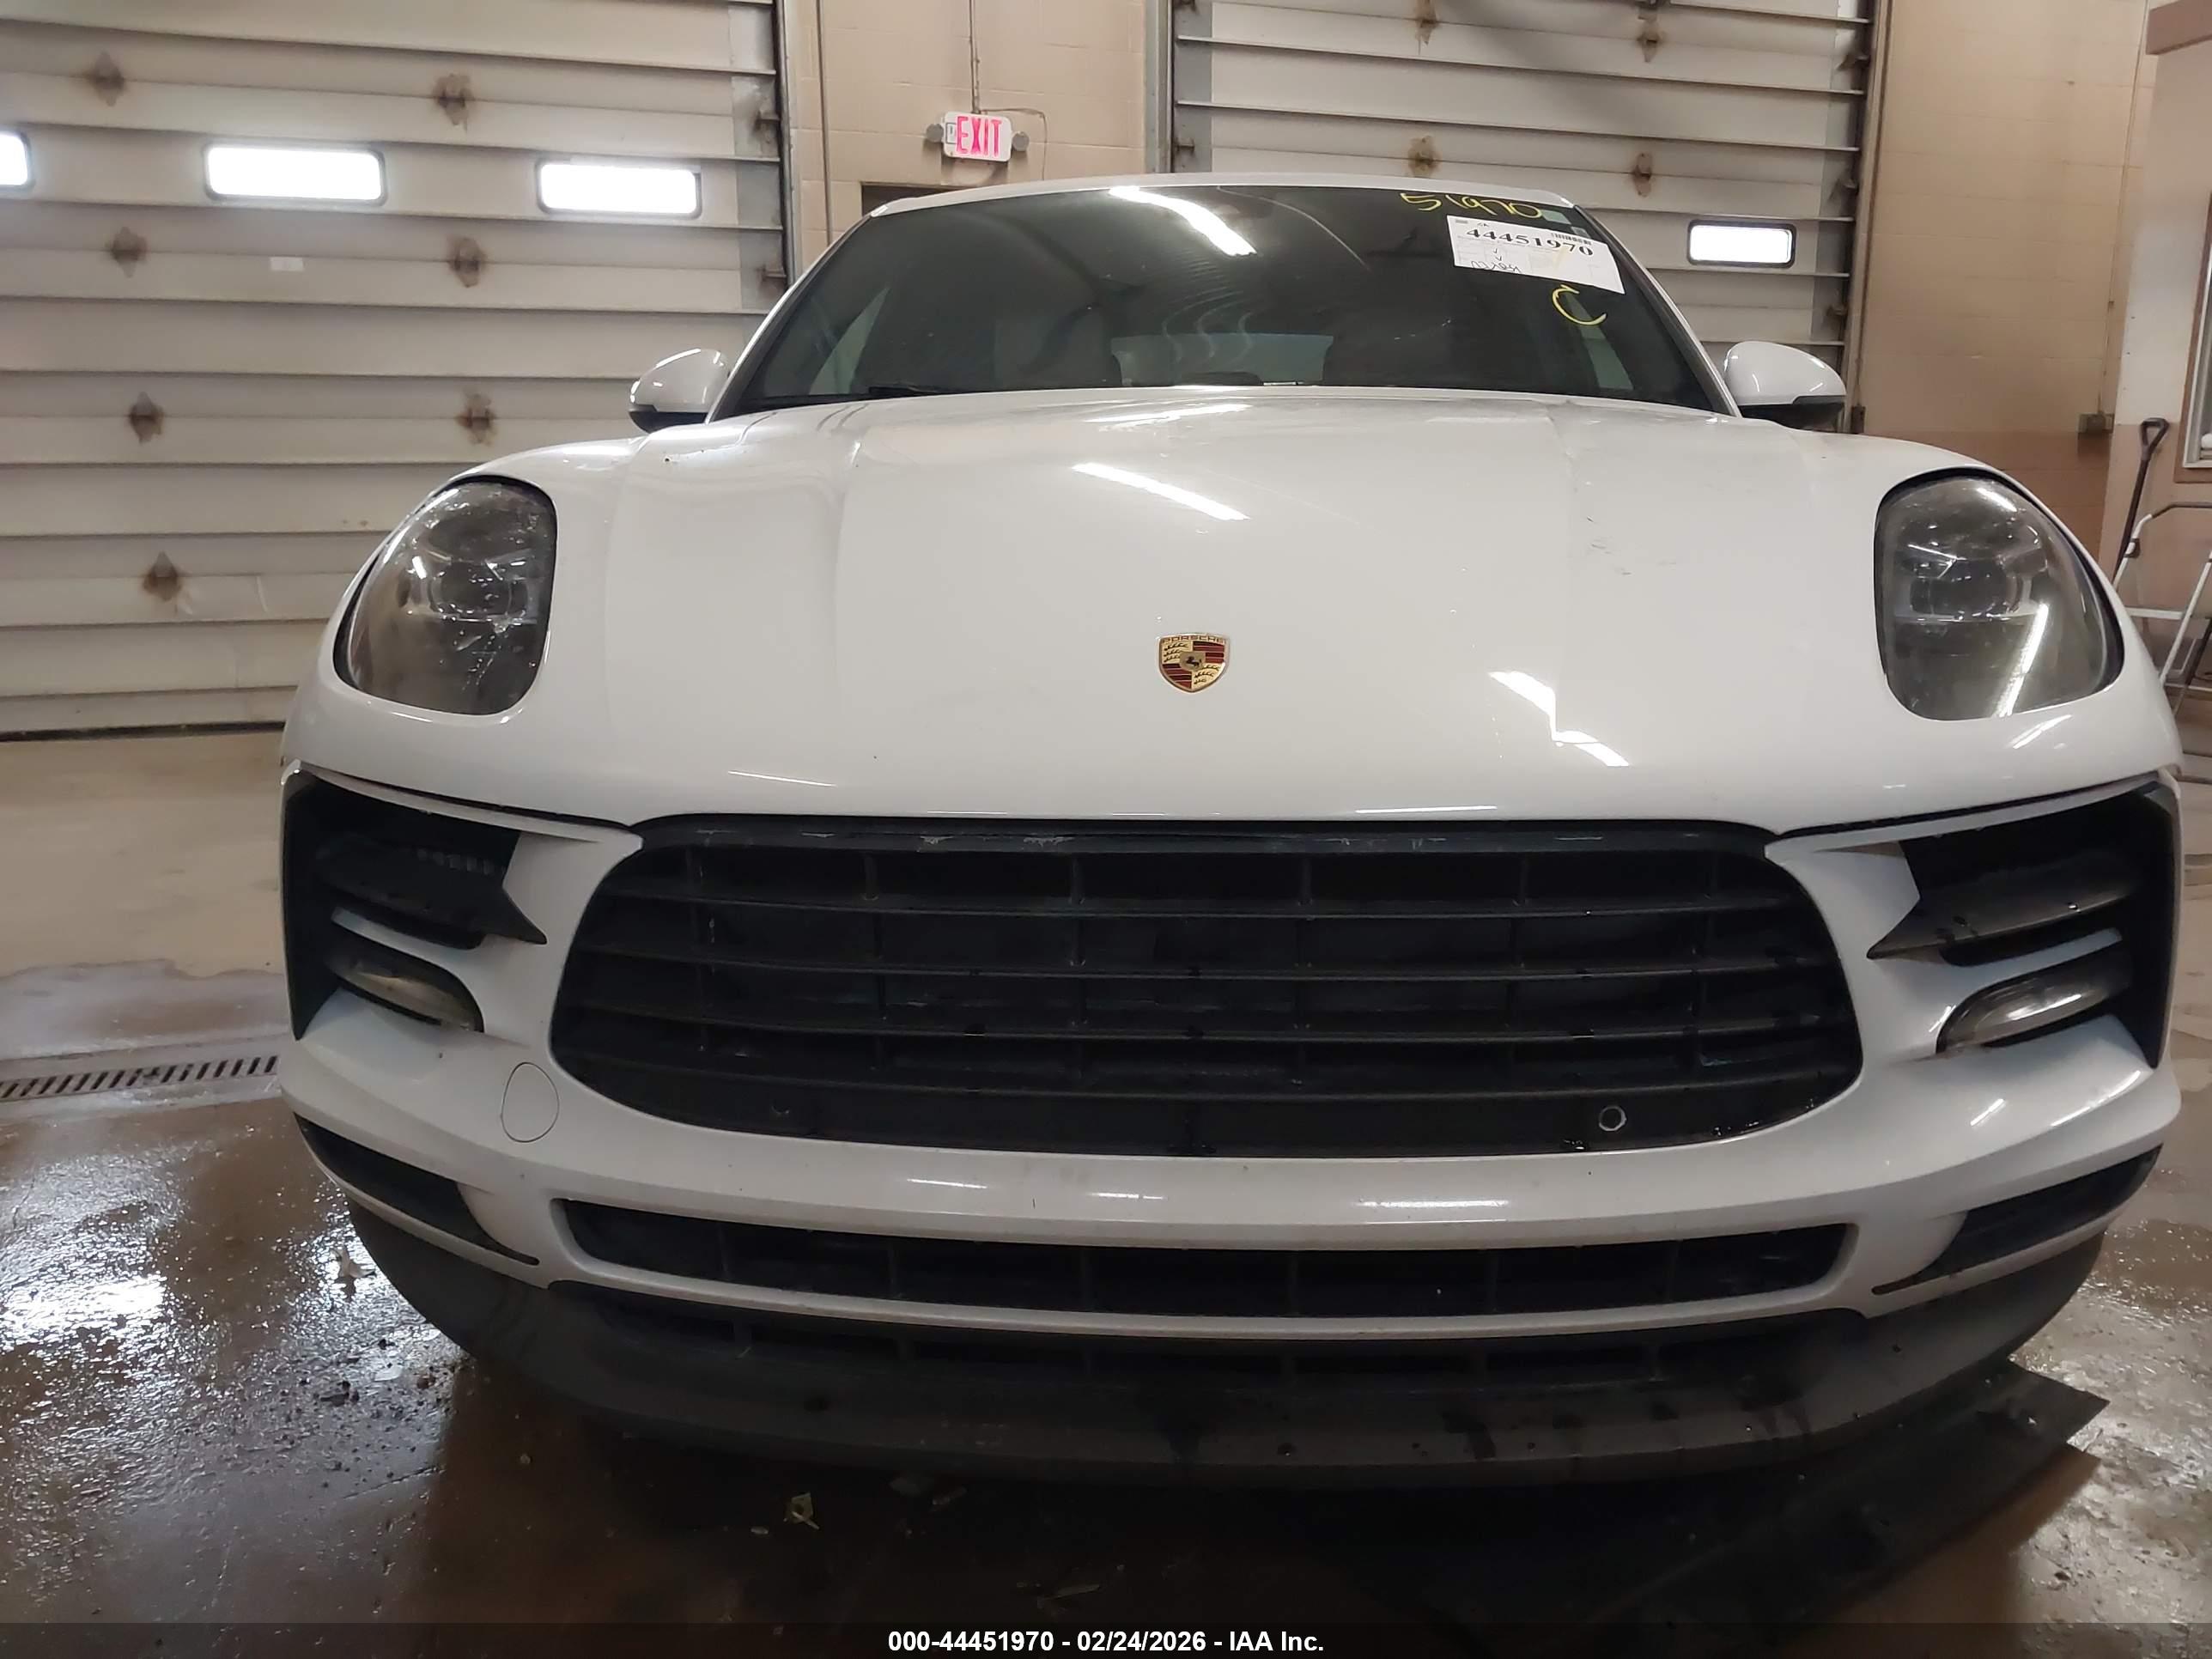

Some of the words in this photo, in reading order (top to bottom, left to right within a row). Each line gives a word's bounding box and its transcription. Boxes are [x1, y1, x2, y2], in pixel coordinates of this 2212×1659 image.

[957, 116, 1002, 156] EXIT
[1400, 192, 1543, 219] 51970
[1466, 228, 1595, 257] 44451970
[1552, 283, 1607, 325] C
